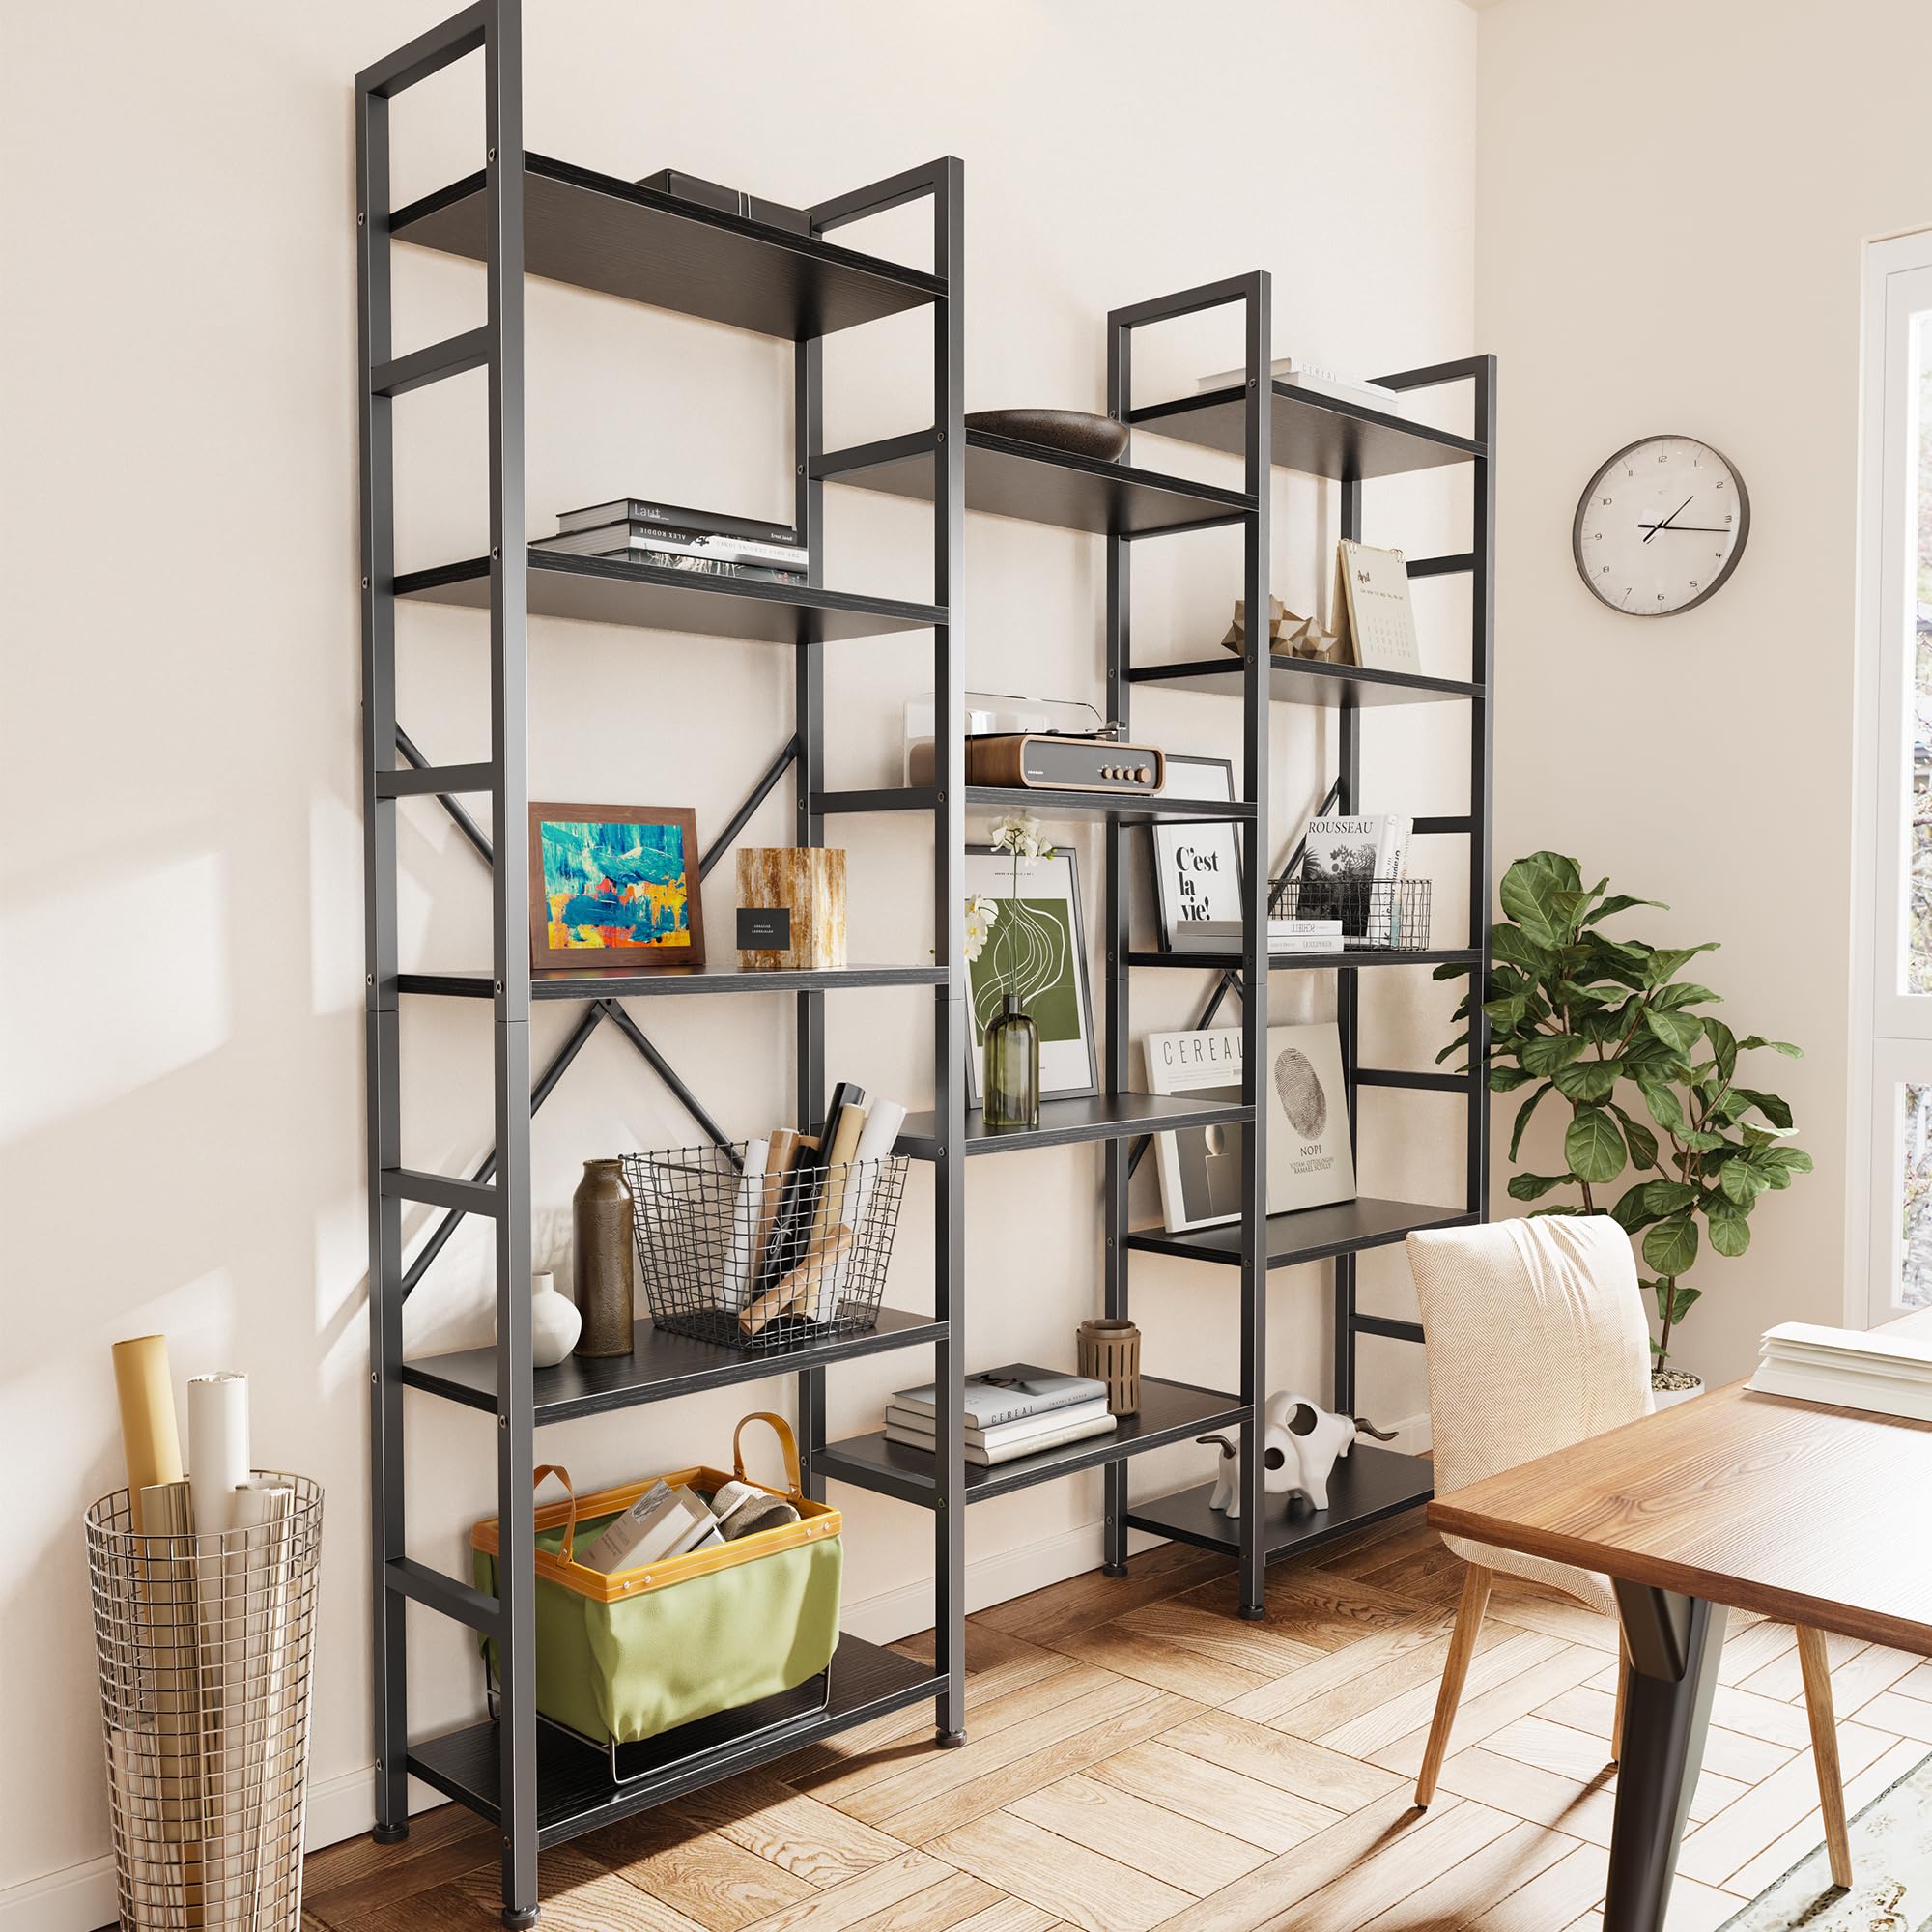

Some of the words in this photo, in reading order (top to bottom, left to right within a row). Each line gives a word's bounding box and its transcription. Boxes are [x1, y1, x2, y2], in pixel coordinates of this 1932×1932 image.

[634, 503, 661, 518] Laut
[639, 527, 667, 538] RODDIE
[1308, 821, 1373, 834] ROUSSEAU
[1178, 871, 1196, 896] la
[1180, 896, 1210, 921] vie!
[1163, 1036, 1243, 1065] CEREAL
[1300, 1144, 1321, 1157] NOPI
